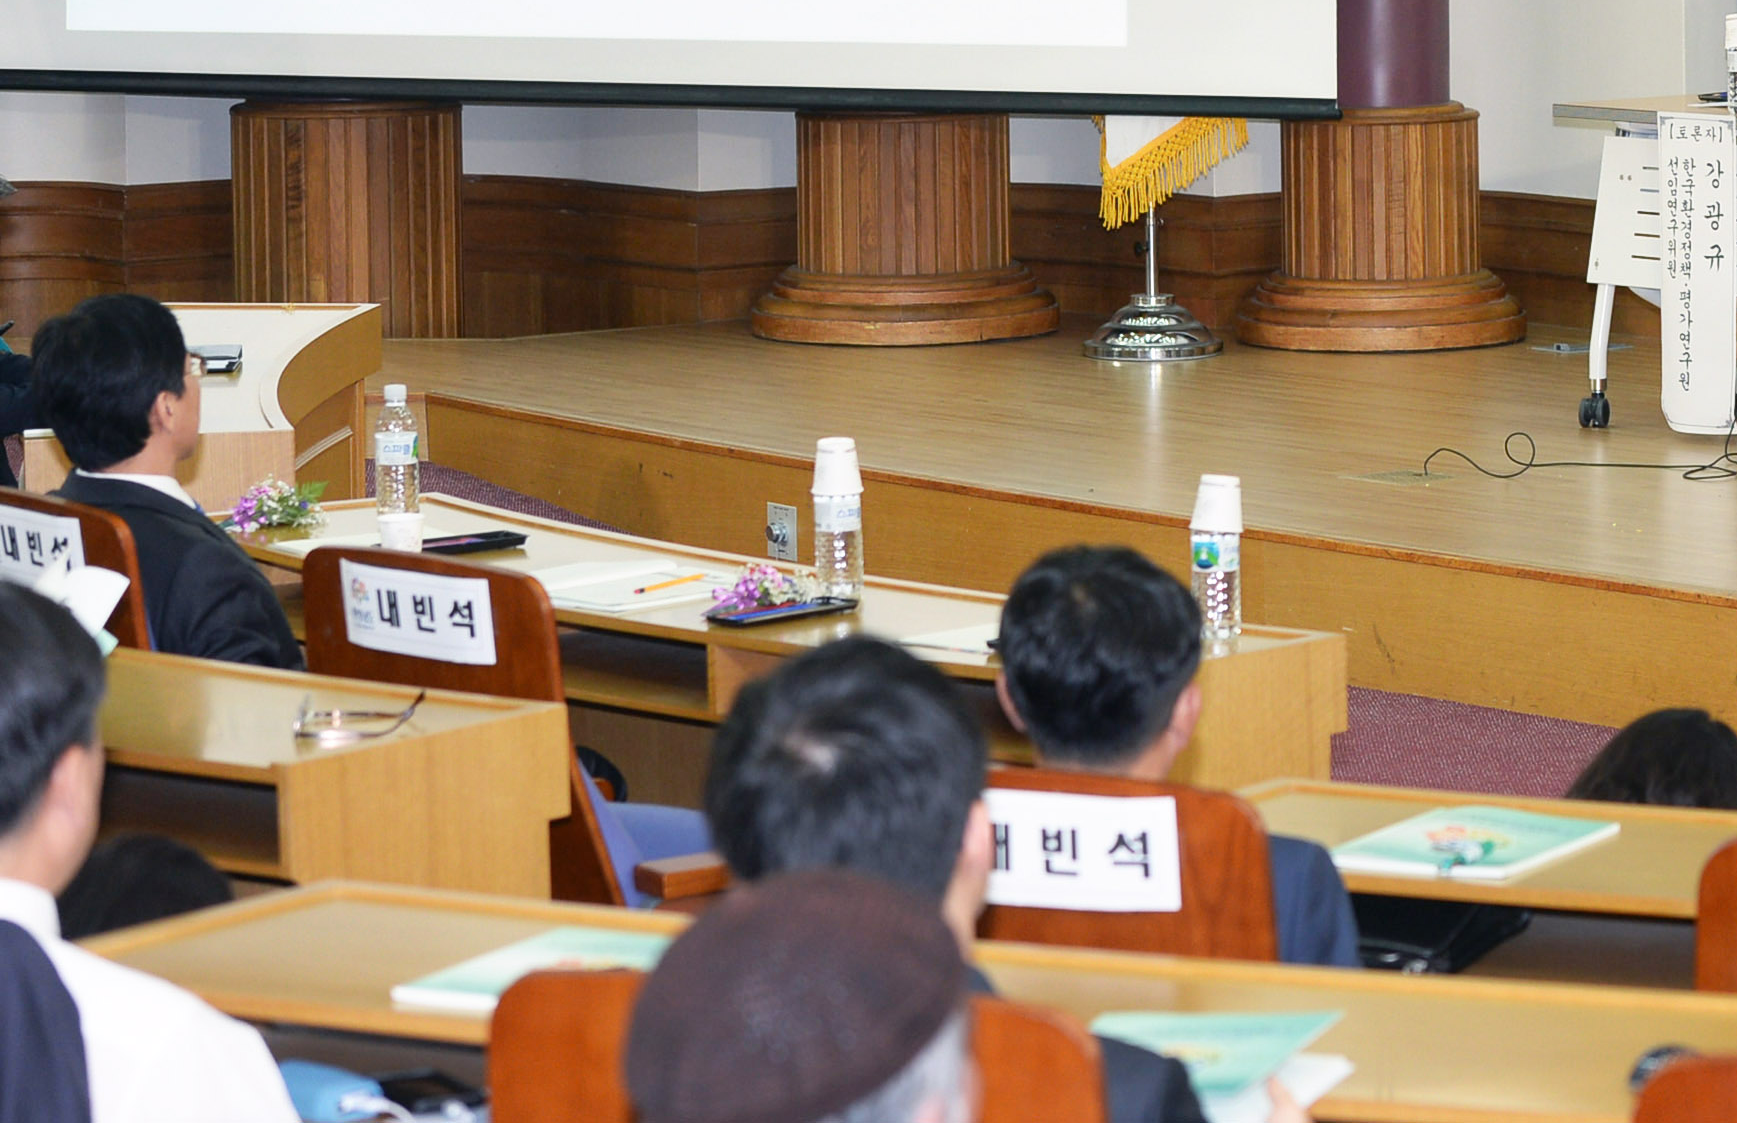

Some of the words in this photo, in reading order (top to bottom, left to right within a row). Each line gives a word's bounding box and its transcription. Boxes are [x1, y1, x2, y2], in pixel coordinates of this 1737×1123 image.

[1666, 156, 1679, 279] 선임연구위원
[1704, 159, 1724, 271] 강광규
[376, 589, 476, 638] 내빈석
